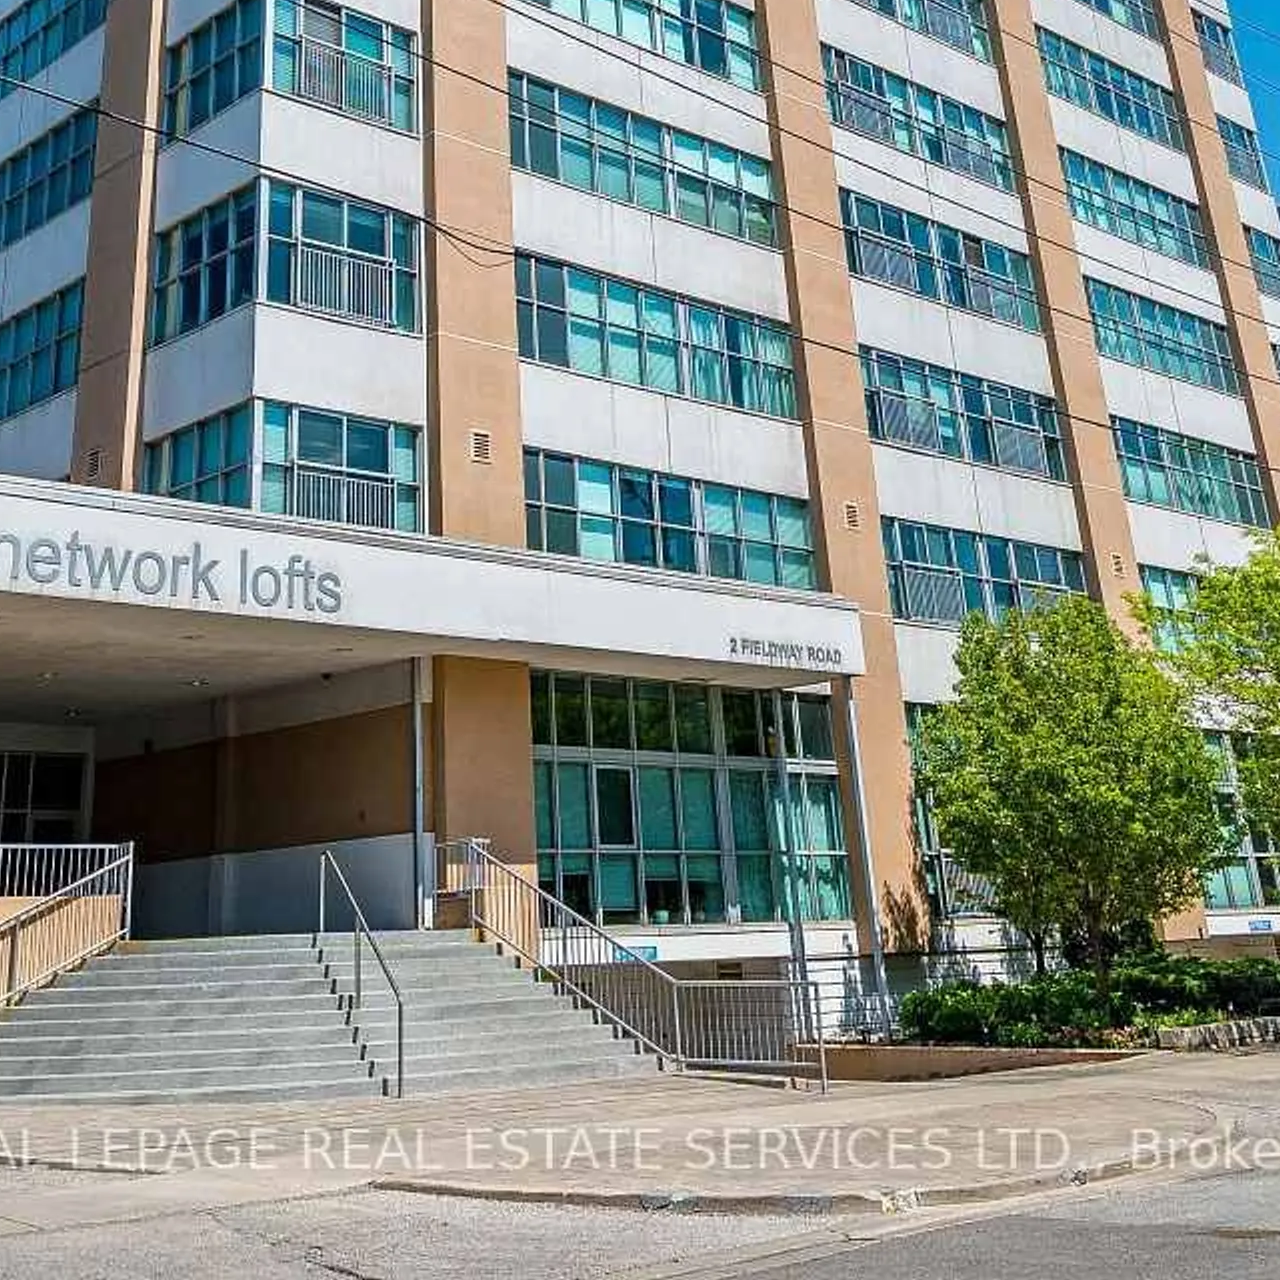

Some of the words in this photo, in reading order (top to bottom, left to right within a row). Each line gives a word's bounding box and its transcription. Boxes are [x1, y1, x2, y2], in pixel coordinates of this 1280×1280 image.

[239, 548, 342, 613] lofts
[729, 638, 738, 654] 2
[740, 639, 803, 660] FIELDWAY
[806, 645, 841, 664] ROAD
